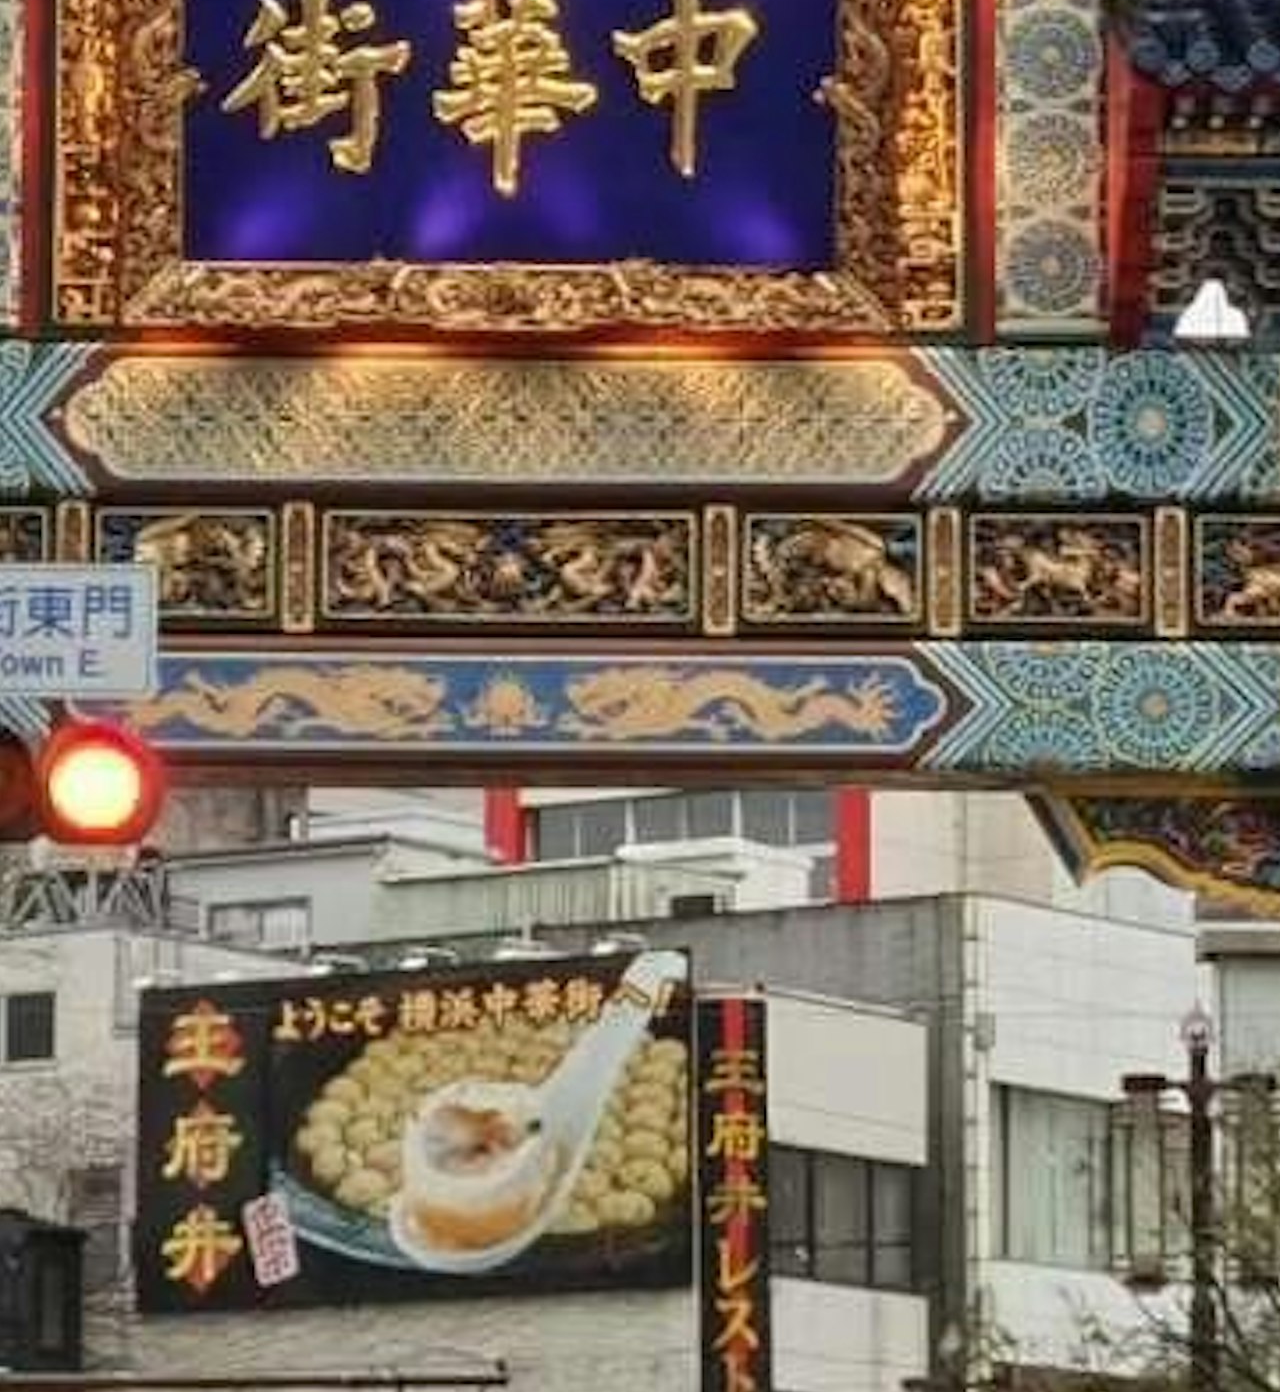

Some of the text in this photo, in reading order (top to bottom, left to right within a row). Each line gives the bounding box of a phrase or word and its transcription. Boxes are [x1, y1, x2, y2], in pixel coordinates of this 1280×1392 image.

[272, 995, 381, 1041] ようこそ
[161, 1013, 246, 1281] 王府井
